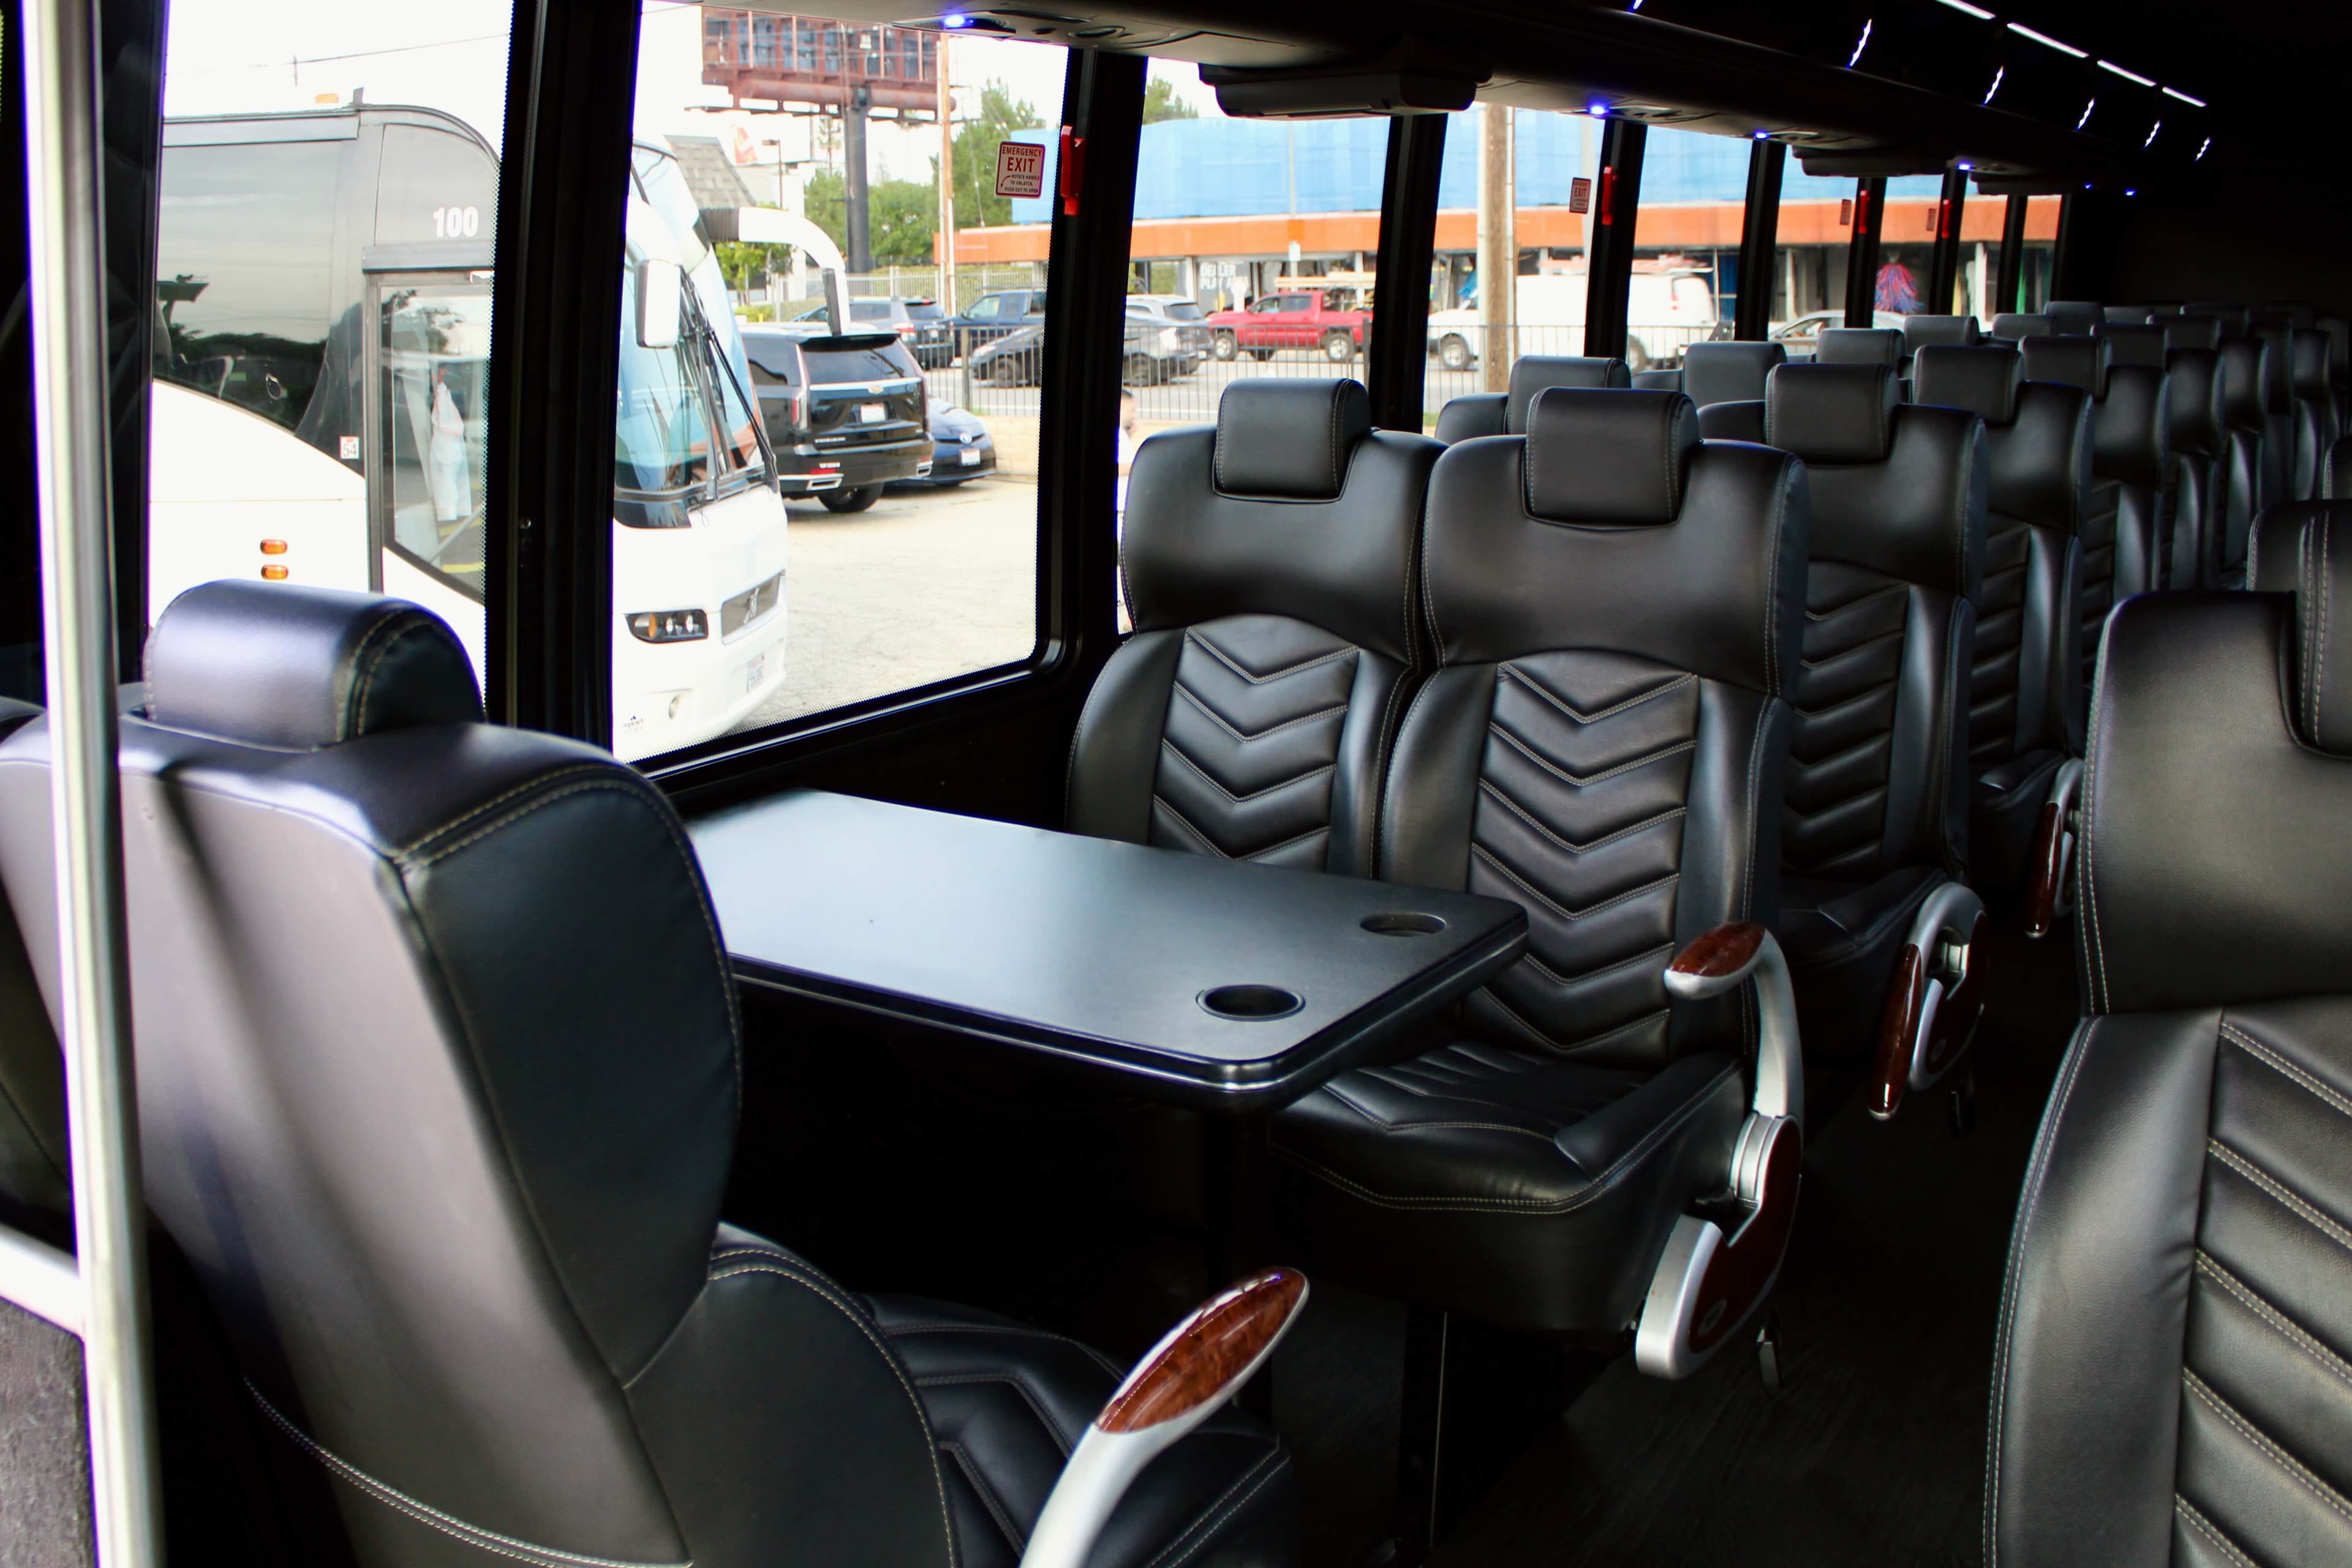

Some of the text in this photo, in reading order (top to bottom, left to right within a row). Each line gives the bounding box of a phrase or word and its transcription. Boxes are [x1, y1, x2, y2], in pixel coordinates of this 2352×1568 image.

[1002, 146, 1042, 157] EMERGENCY
[1007, 157, 1035, 173] EXIT
[1574, 187, 1587, 197] EXIT
[432, 206, 479, 238] 100
[342, 443, 356, 457] 54
